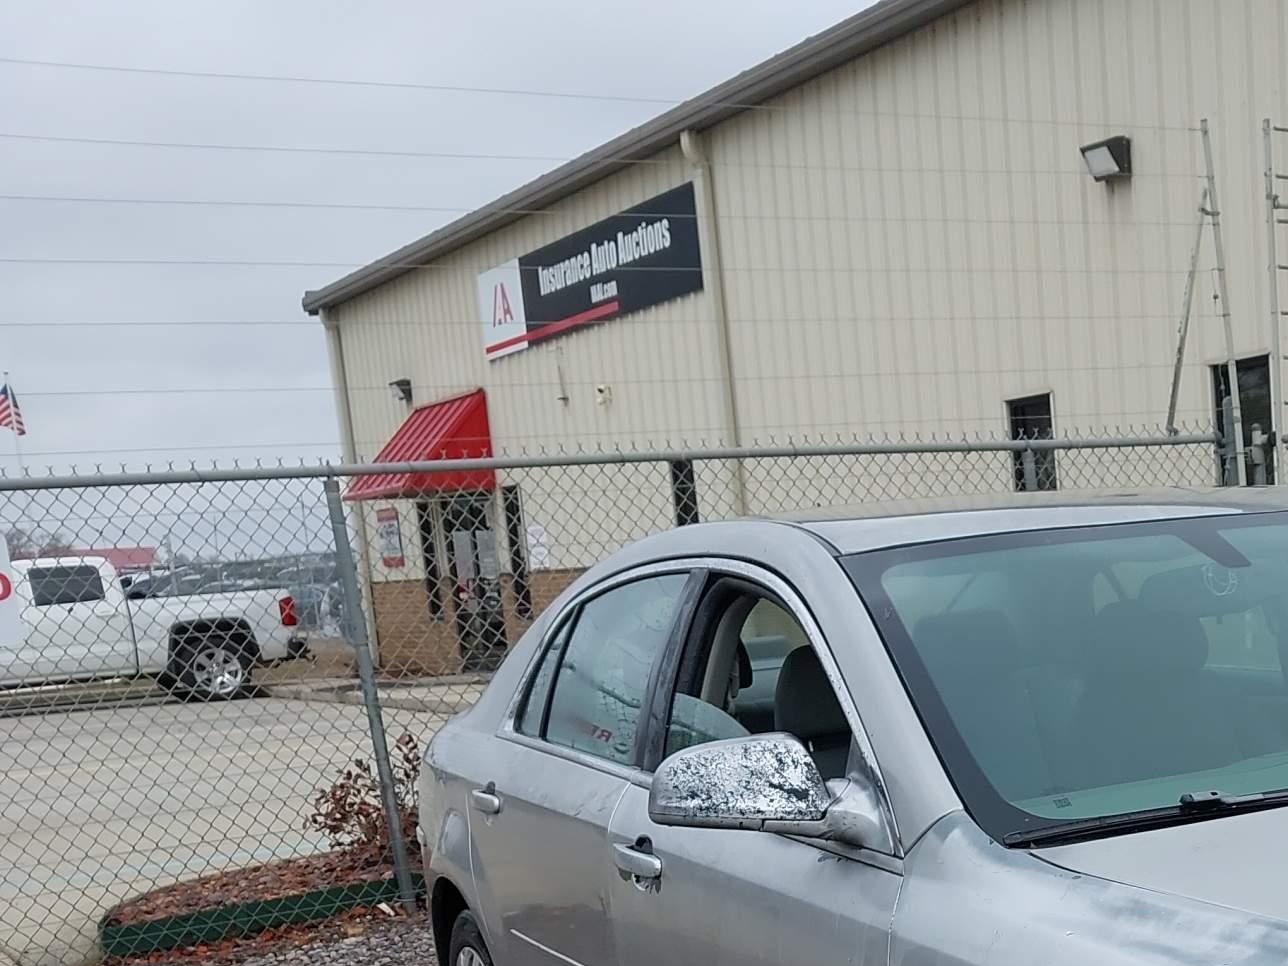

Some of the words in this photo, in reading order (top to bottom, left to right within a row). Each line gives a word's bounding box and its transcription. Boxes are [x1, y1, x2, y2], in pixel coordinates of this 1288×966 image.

[538, 251, 591, 296] Insurance
[590, 238, 618, 276] Auto
[617, 218, 671, 266] Auctions
